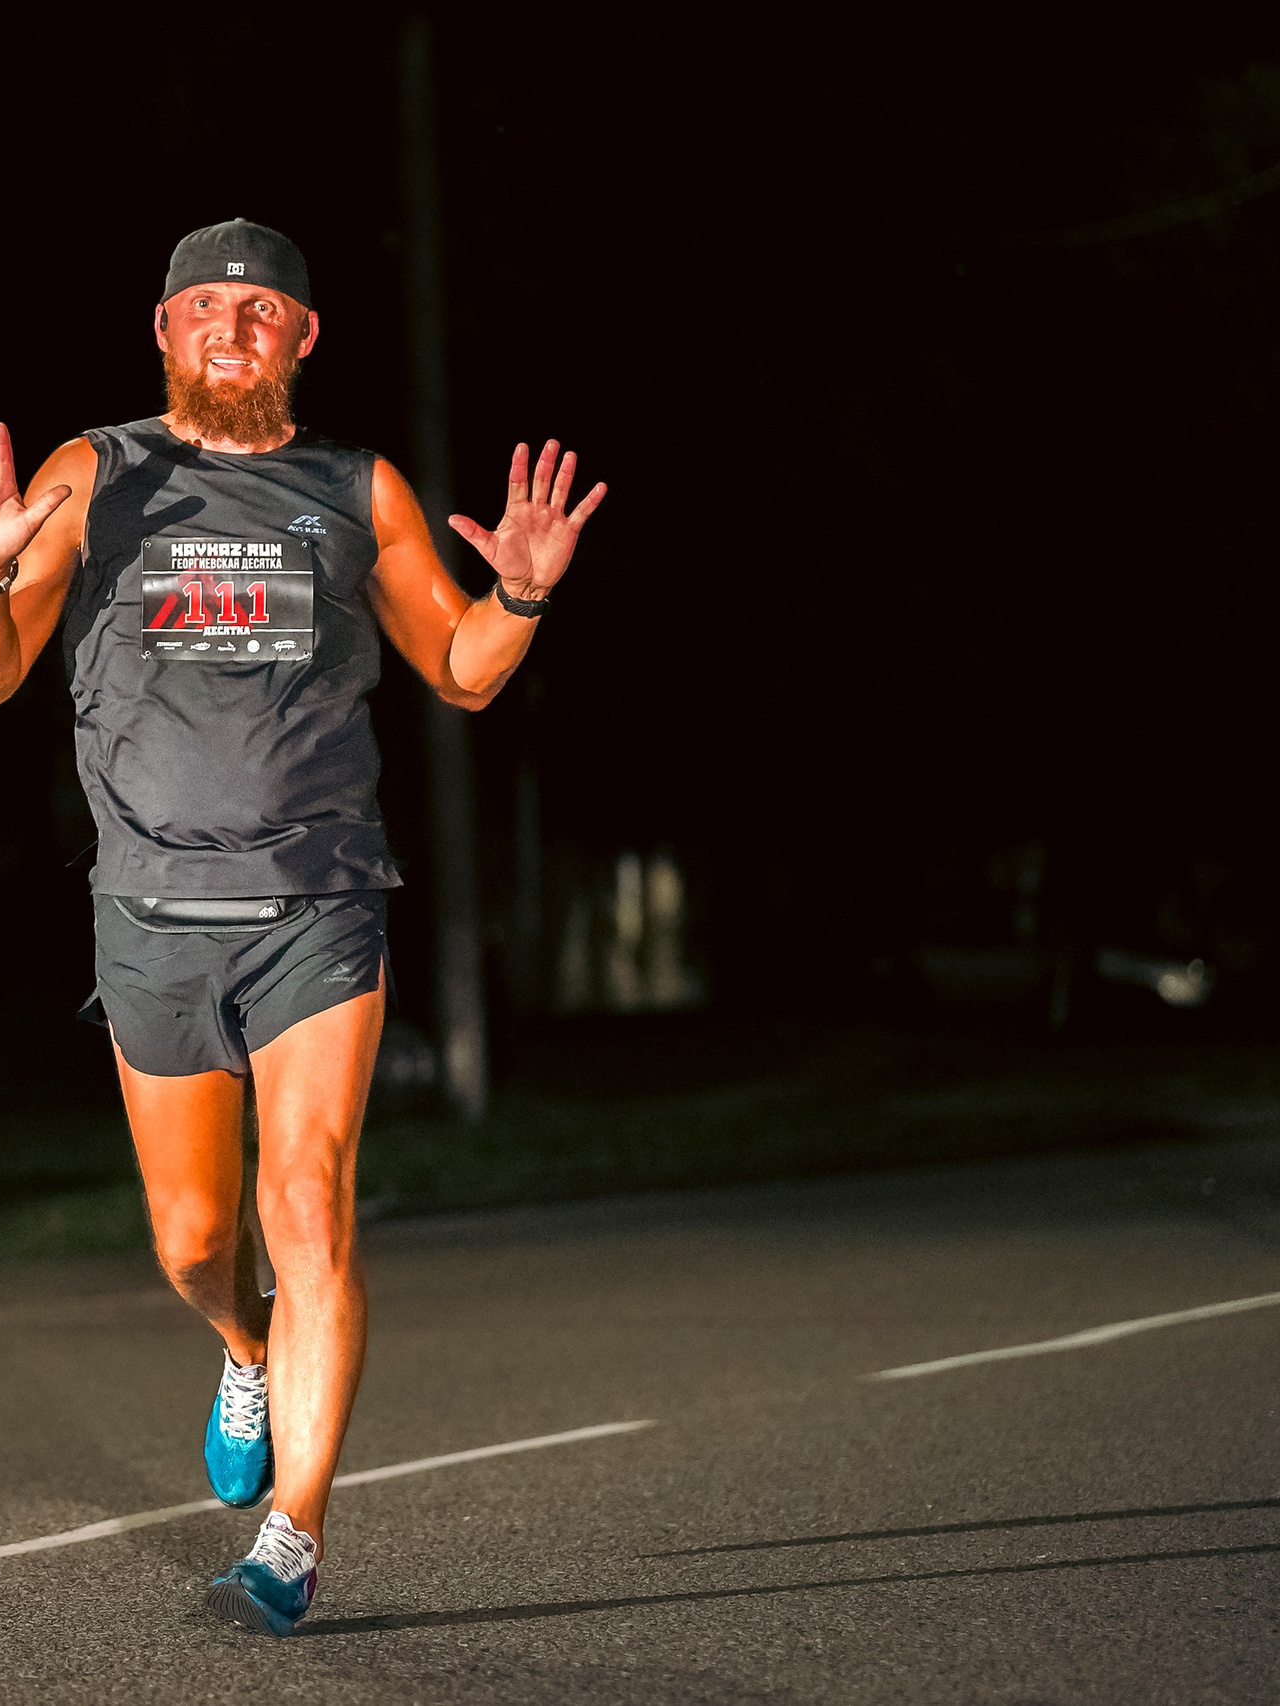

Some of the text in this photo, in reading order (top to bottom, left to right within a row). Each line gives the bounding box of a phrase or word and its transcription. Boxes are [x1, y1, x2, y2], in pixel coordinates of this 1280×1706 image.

[171, 558, 283, 570] ГЕОРГИЕВСКАЯ ДЕСЯТКА
[182, 581, 269, 624] 111
[203, 625, 251, 636] ДЕСЯТКА
